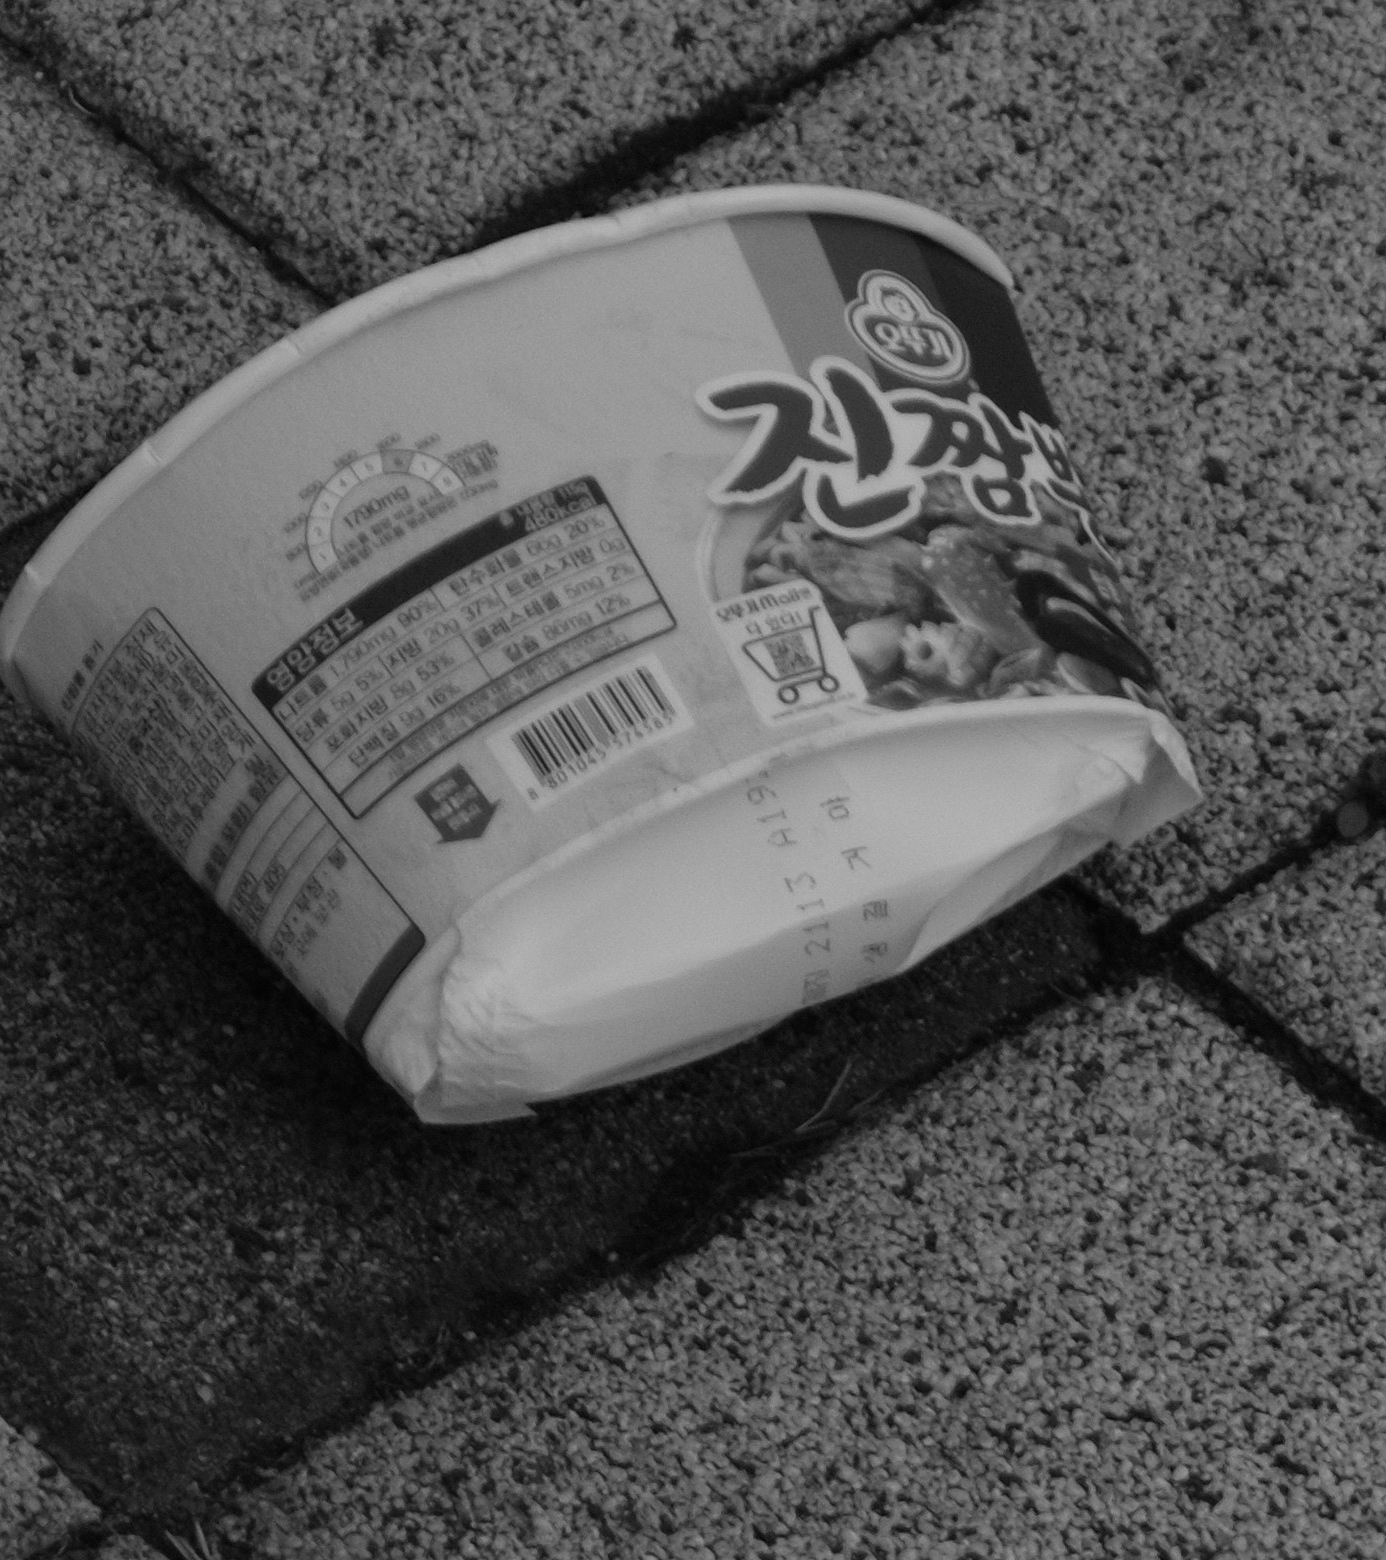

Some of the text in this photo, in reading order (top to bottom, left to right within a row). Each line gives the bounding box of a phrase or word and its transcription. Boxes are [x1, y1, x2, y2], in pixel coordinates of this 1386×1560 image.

[873, 318, 958, 362] 오뚜기
[342, 484, 411, 530] 1790mg
[523, 492, 592, 533] 480kcal
[567, 514, 606, 540] 20%
[397, 594, 436, 624] 90%
[594, 591, 631, 617] 12%
[267, 607, 365, 692] 영양정보
[386, 636, 423, 670] 지방
